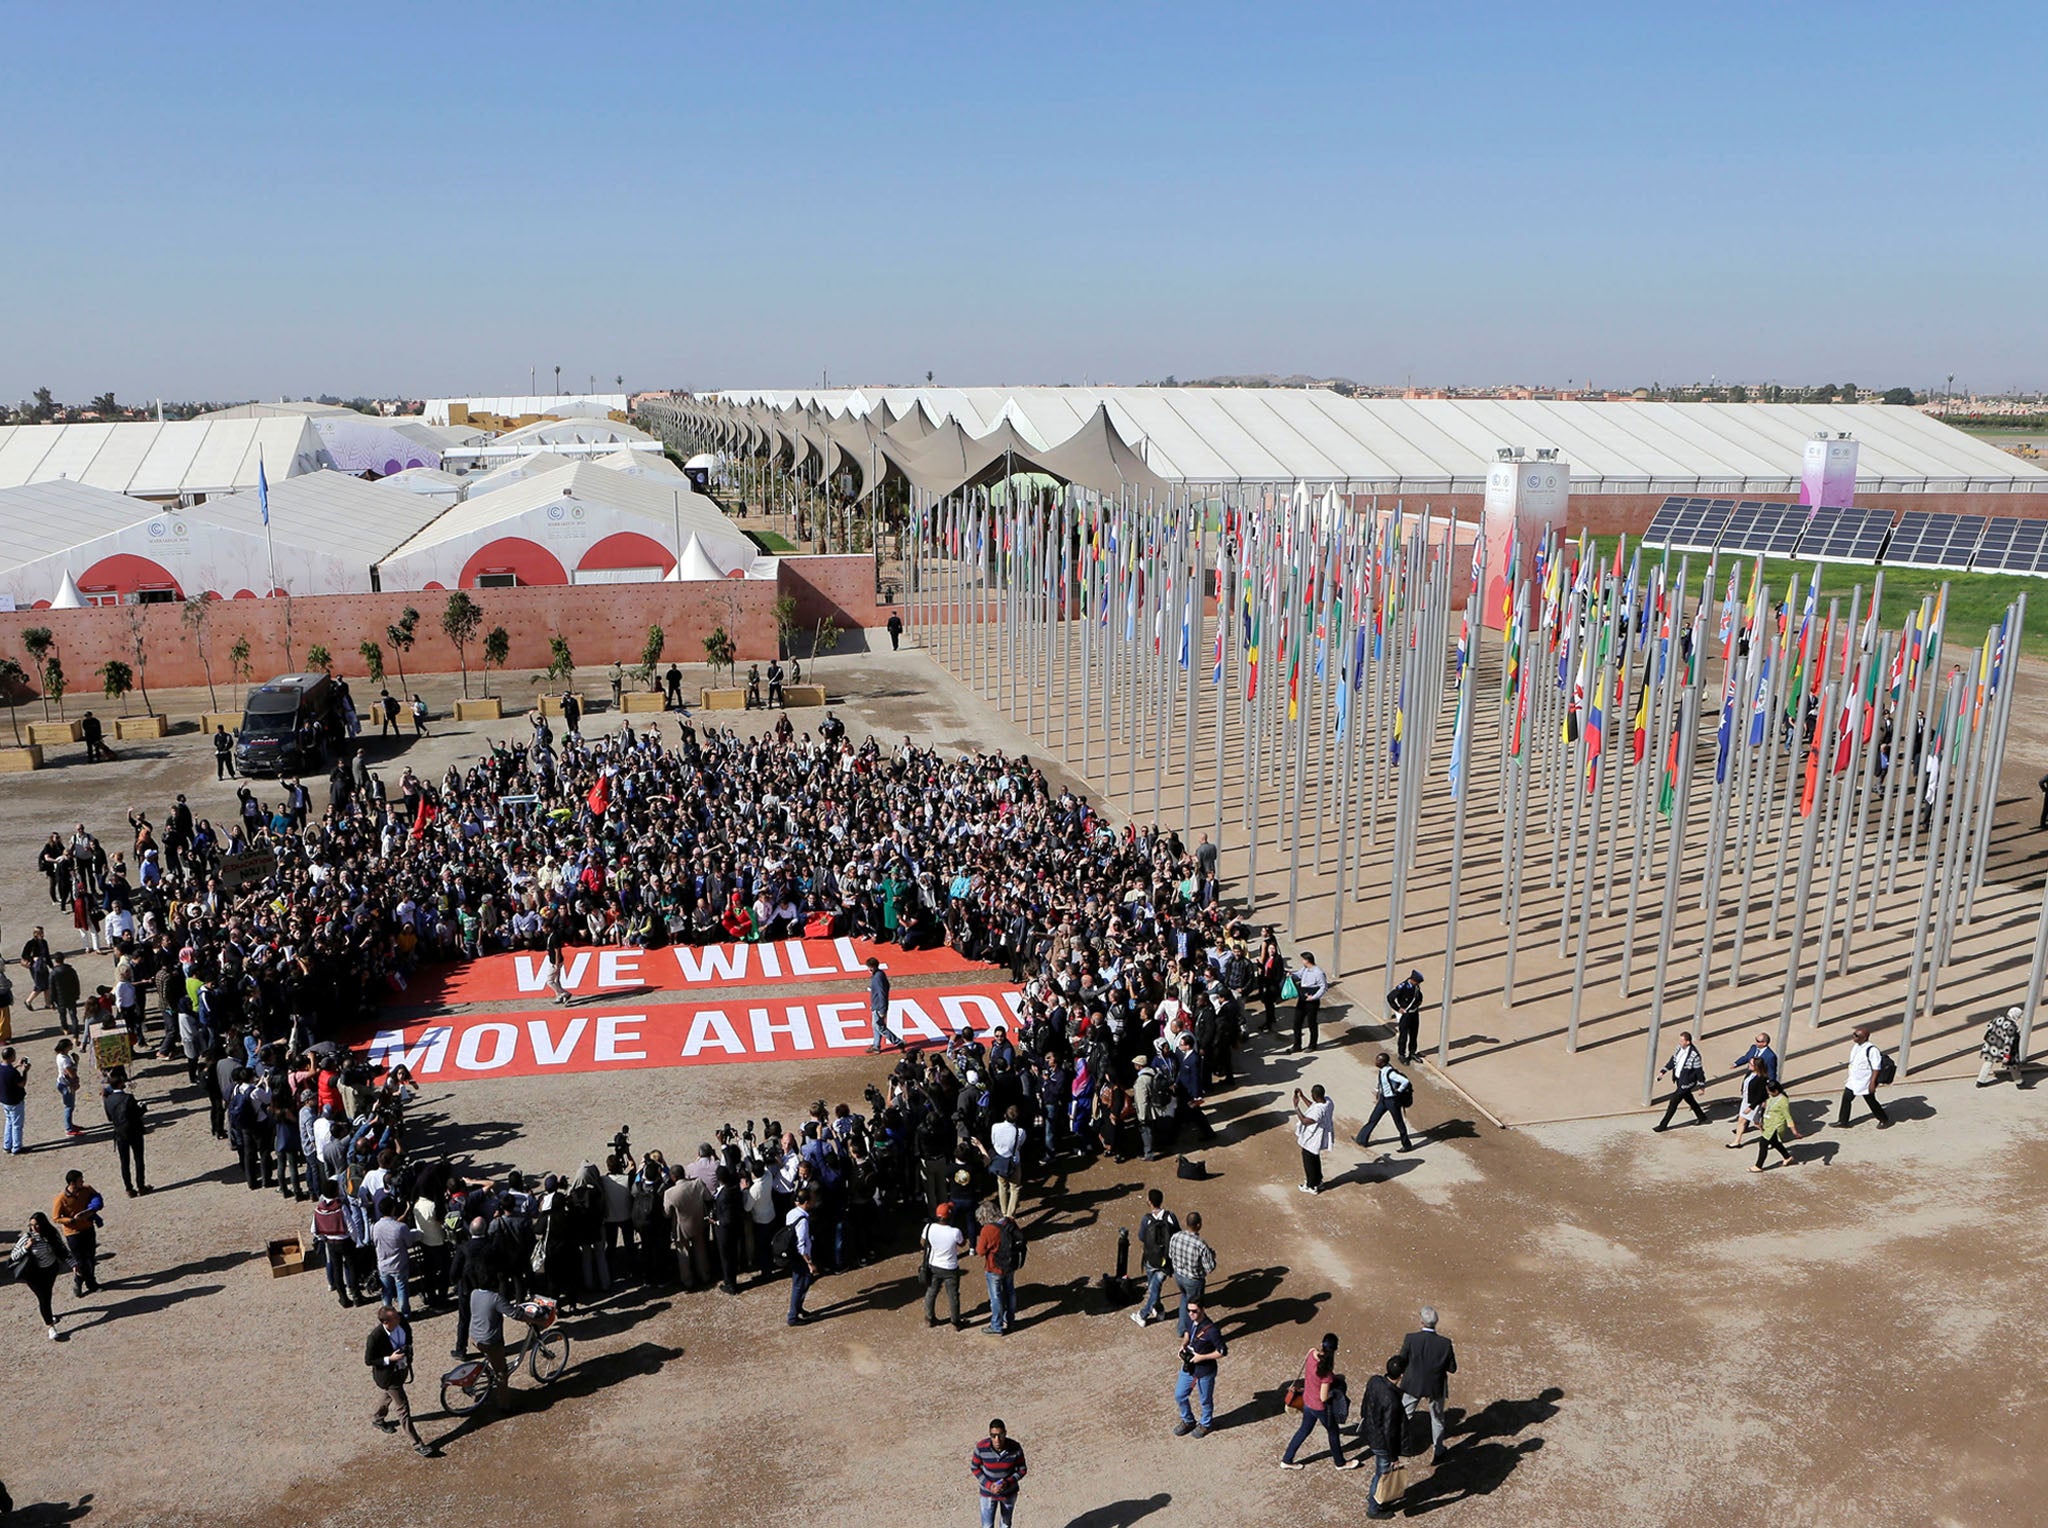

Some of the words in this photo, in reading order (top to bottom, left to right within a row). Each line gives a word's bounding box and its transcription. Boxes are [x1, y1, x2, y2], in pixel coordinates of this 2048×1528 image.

[514, 949, 646, 992] WE
[674, 936, 888, 982] WILL
[366, 1014, 647, 1074] MOVE
